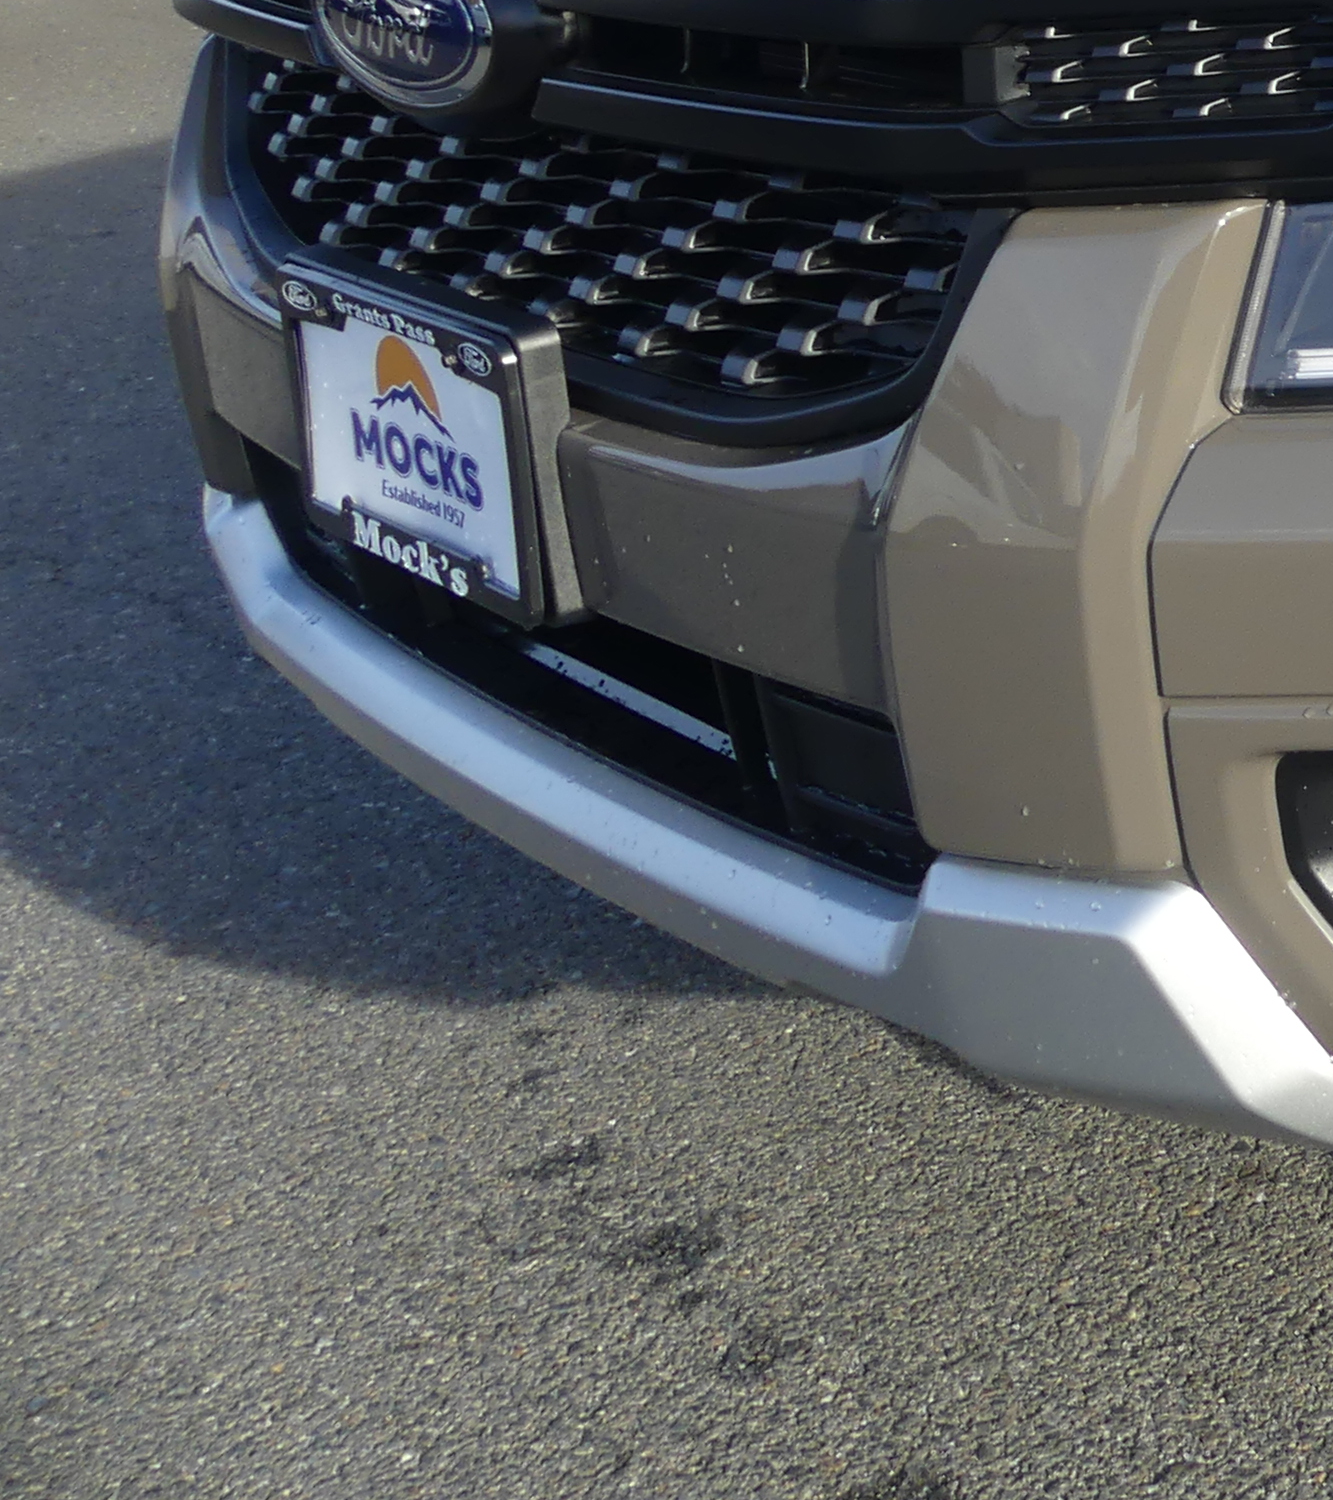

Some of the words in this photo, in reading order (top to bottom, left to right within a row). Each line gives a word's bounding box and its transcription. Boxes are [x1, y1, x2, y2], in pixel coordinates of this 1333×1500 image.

[332, 293, 391, 329] Grants
[390, 313, 435, 346] Pass
[350, 407, 485, 512] MOCKS
[382, 479, 441, 517] Established
[443, 502, 465, 529] 1957
[351, 511, 469, 597] Mock's
